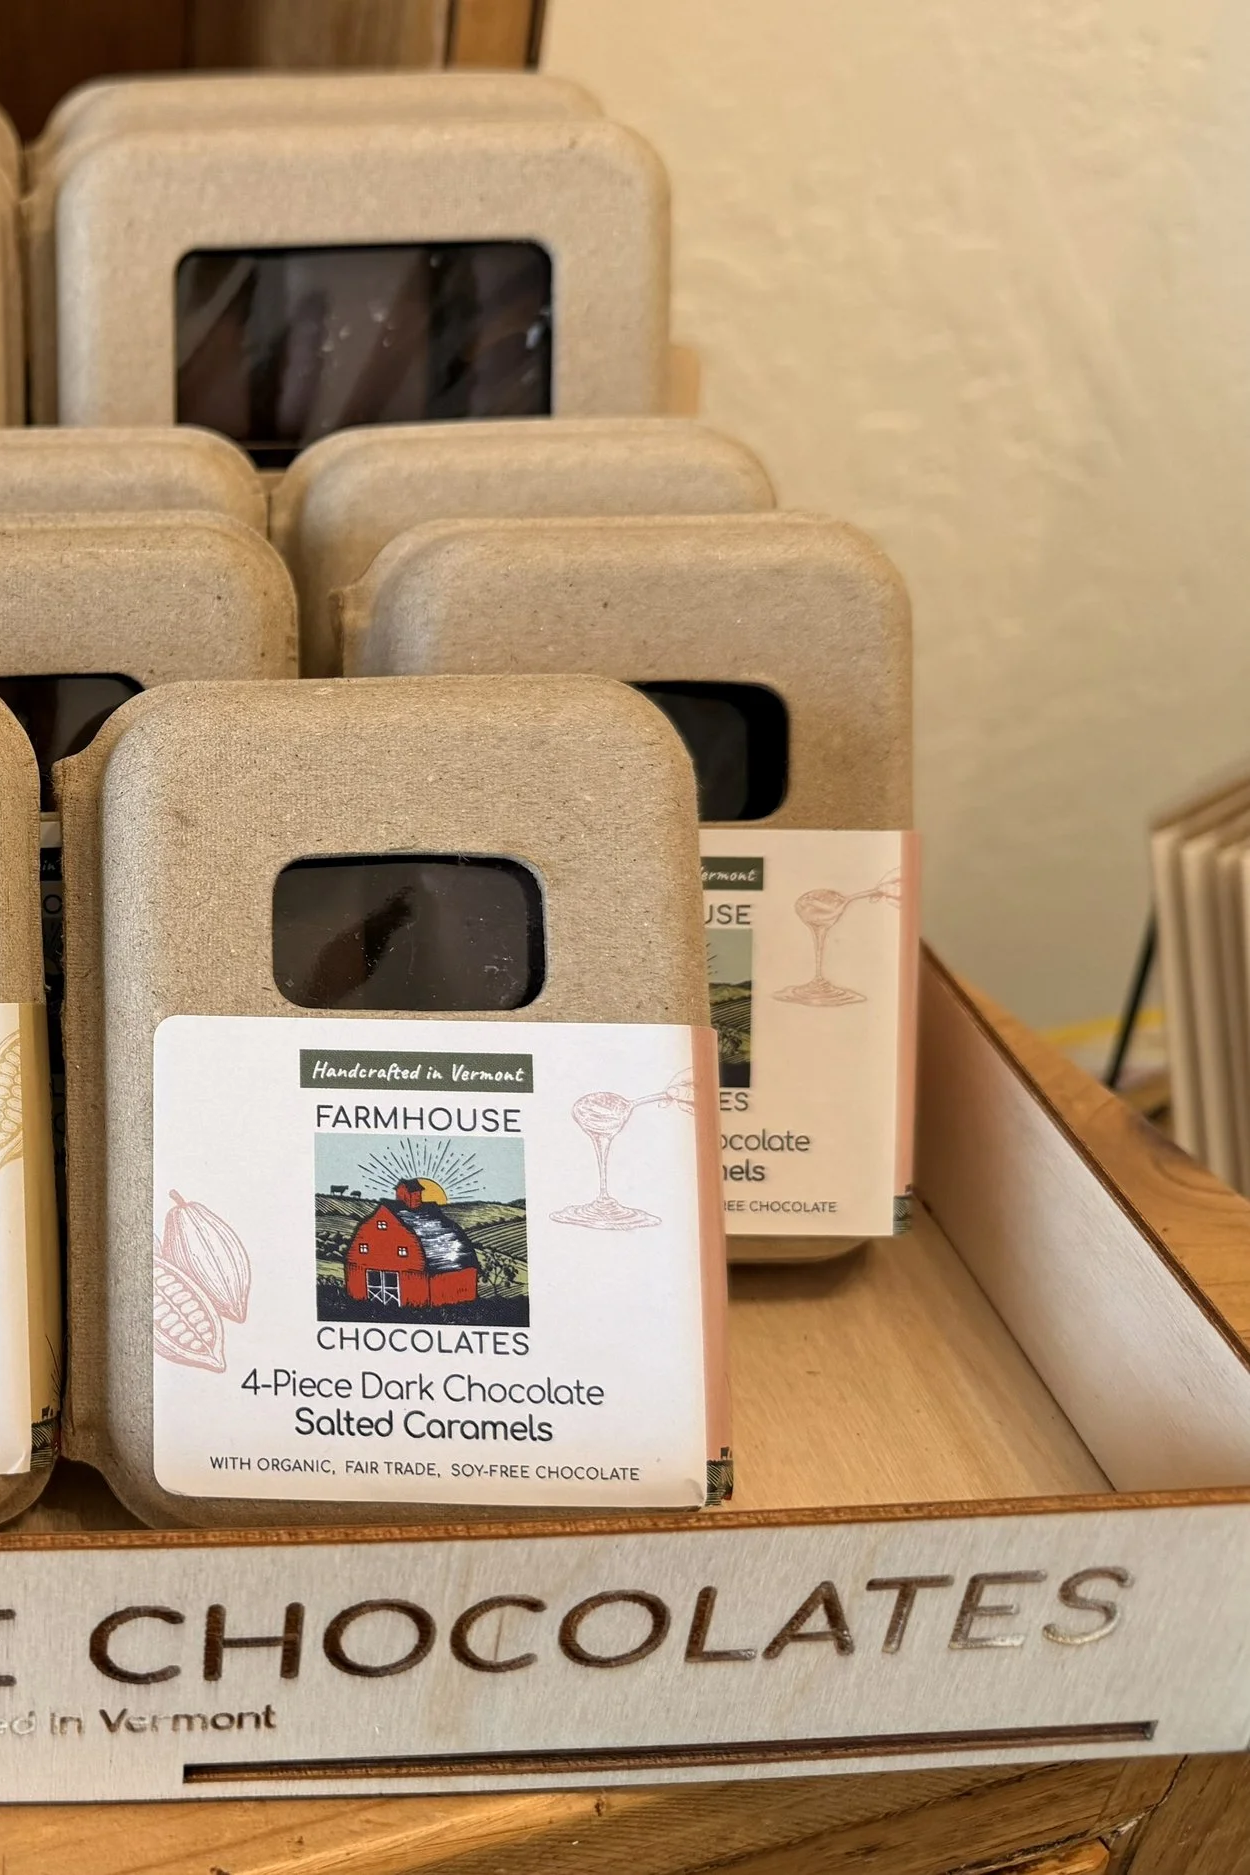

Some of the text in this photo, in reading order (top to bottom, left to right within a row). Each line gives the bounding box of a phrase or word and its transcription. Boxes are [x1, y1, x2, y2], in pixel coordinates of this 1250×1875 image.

[701, 866, 758, 882] ermont
[312, 1060, 525, 1082] Handcrafted in Vermont
[316, 1105, 522, 1133] FARMHOUSE
[721, 1128, 810, 1151] colate
[750, 1200, 837, 1212] CHOCOLATE
[316, 1326, 530, 1356] CHOCOLATES
[241, 1367, 605, 1406] 4-Piece Dark Chocolate
[294, 1406, 554, 1442] Salted Caramels
[210, 1455, 640, 1482] WITH ORGANIC, FAIR TRADE, SOY-FREE CHOCOLATE
[88, 1565, 1139, 1687] CHOCOLATES
[50, 1710, 84, 1736] in
[99, 1703, 278, 1734] Vermont
